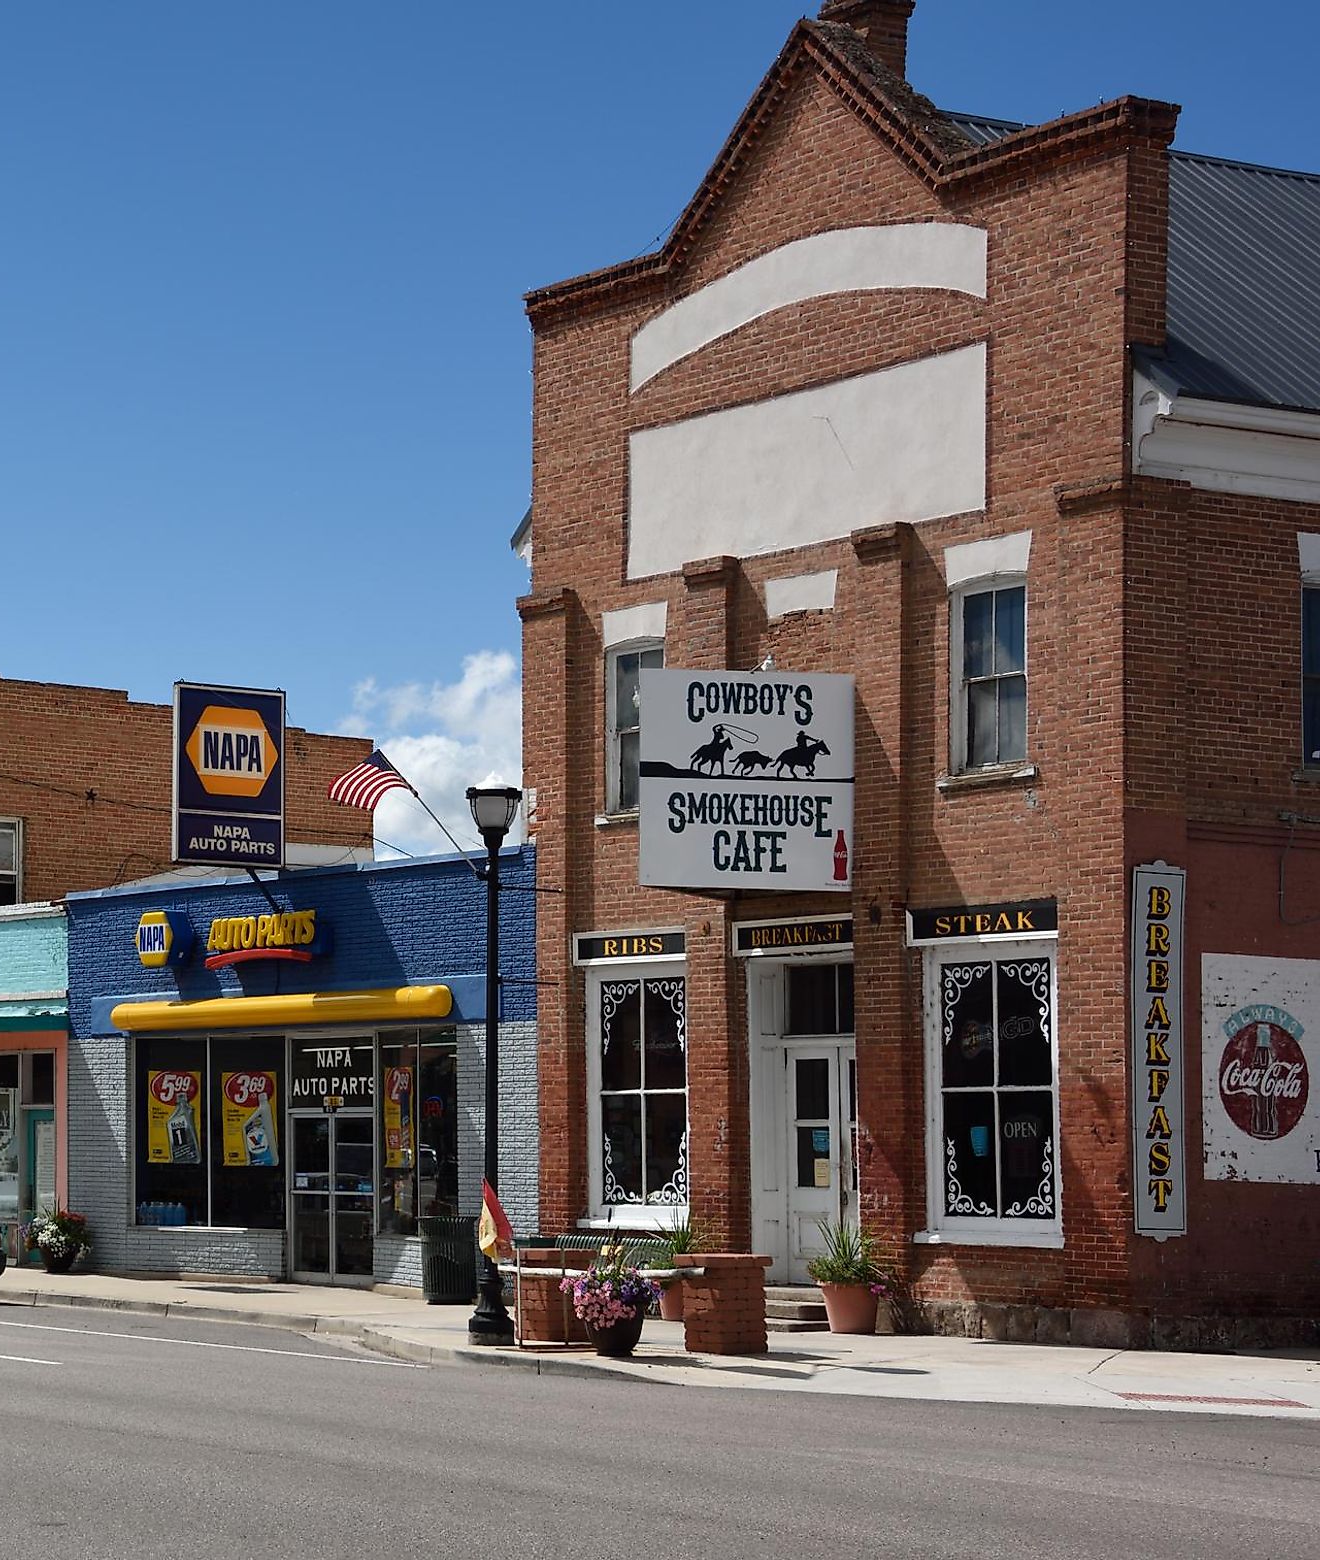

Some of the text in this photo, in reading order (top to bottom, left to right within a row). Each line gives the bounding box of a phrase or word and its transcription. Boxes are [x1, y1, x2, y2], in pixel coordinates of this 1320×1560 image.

[686, 681, 814, 726] COWBOY'S
[203, 730, 262, 774] NAPA
[667, 792, 833, 838] SMOKEHOUSE
[213, 825, 251, 840] NAPA
[189, 837, 276, 855] AUTO PARTS
[713, 829, 787, 873] CAFE
[207, 909, 316, 951] AUTO PARTS
[935, 910, 1035, 935] STEAK
[139, 925, 165, 952] NAPA
[603, 936, 664, 956] RIBS
[1228, 1008, 1298, 1034] ALWAYS
[317, 1050, 352, 1068] NAPA
[1145, 886, 1173, 1213] BREAKFAST
[293, 1077, 374, 1096] AUTO PARTS
[1221, 1059, 1304, 1098] Coca-Cola
[1003, 1121, 1038, 1139] OPEN
